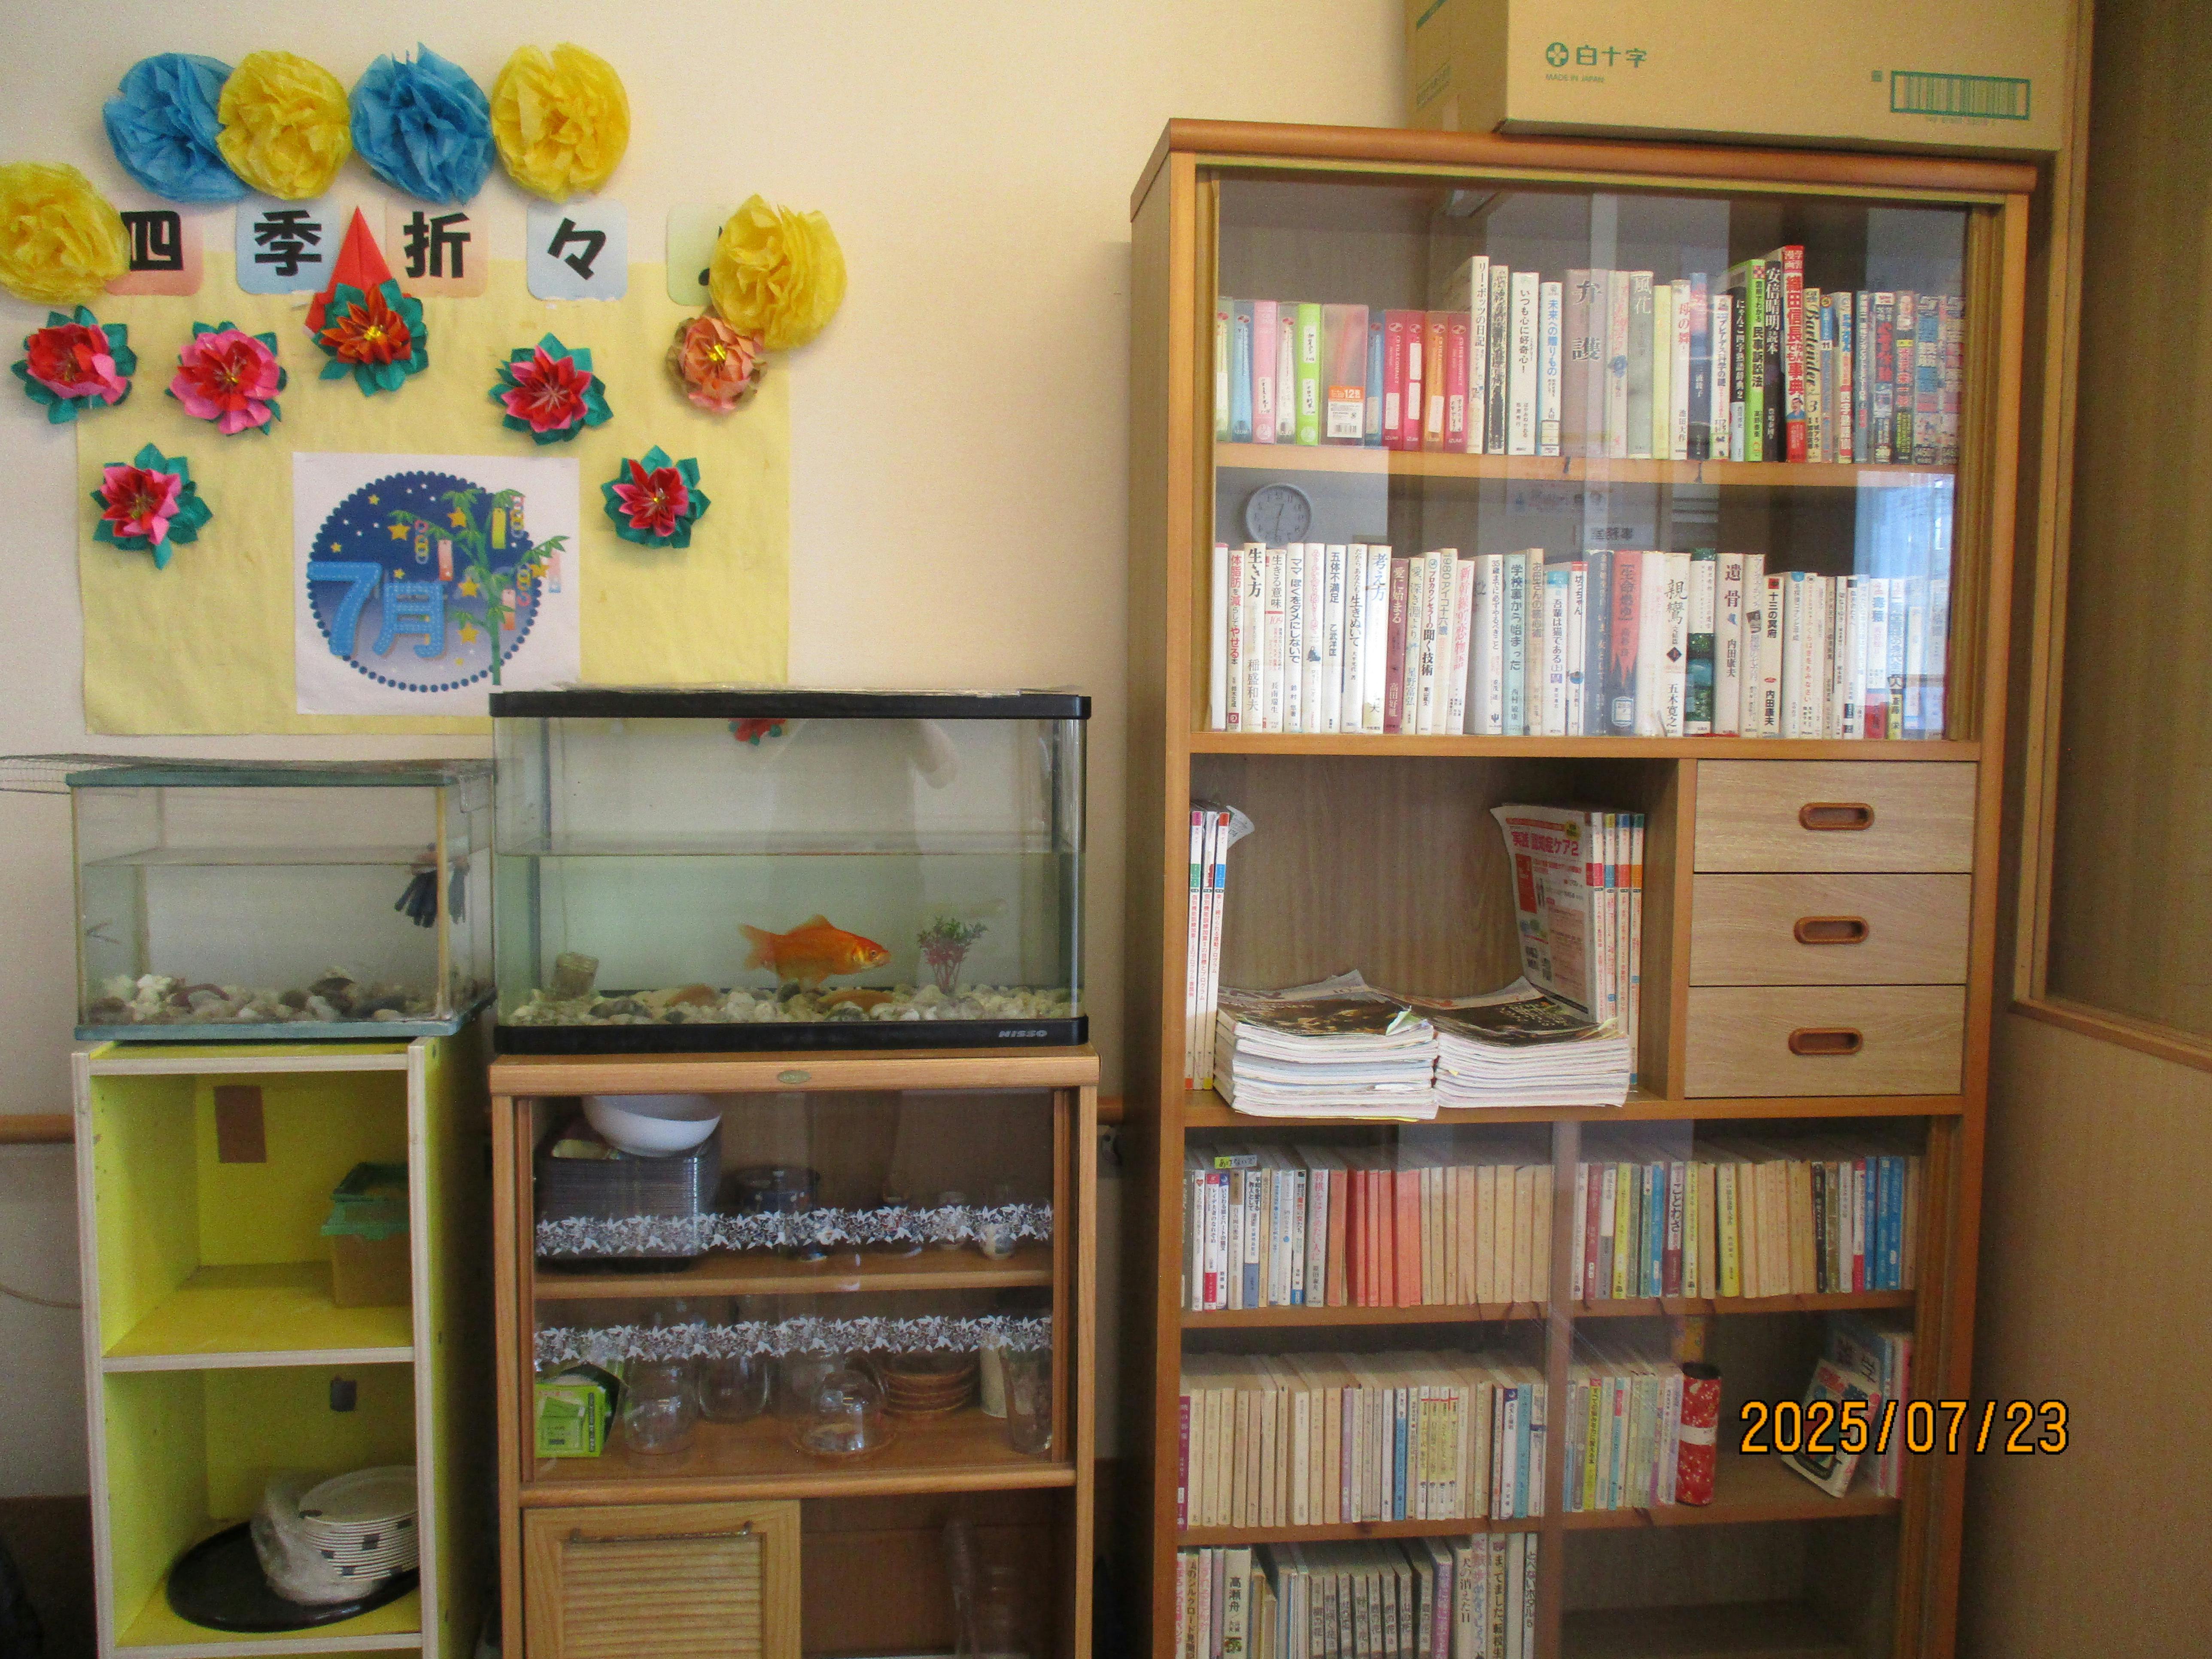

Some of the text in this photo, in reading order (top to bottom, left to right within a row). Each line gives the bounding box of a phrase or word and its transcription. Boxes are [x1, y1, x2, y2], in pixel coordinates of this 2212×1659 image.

[1577, 45, 1647, 68] 白十字
[121, 210, 606, 280] 四季折々
[1808, 400, 1817, 413] 3
[1248, 548, 1262, 598] 生き方
[1271, 556, 1282, 608] 生きる意味
[1330, 552, 1341, 603] 五体不満足
[1371, 553, 1387, 601] 考え方
[1725, 564, 1741, 608] 遺骨
[306, 561, 445, 659] 7月
[1664, 579, 1687, 625] 親鸞
[1767, 591, 1779, 638] 十三の冥府
[1329, 624, 1337, 656] 乙武洋匡
[1726, 638, 1737, 678] 内田康夫
[1247, 659, 1260, 712] 稲盛和夫
[1406, 668, 1416, 706] 星野富弘
[1666, 684, 1679, 727] 五木寛之
[1765, 690, 1776, 726] 内田康夫
